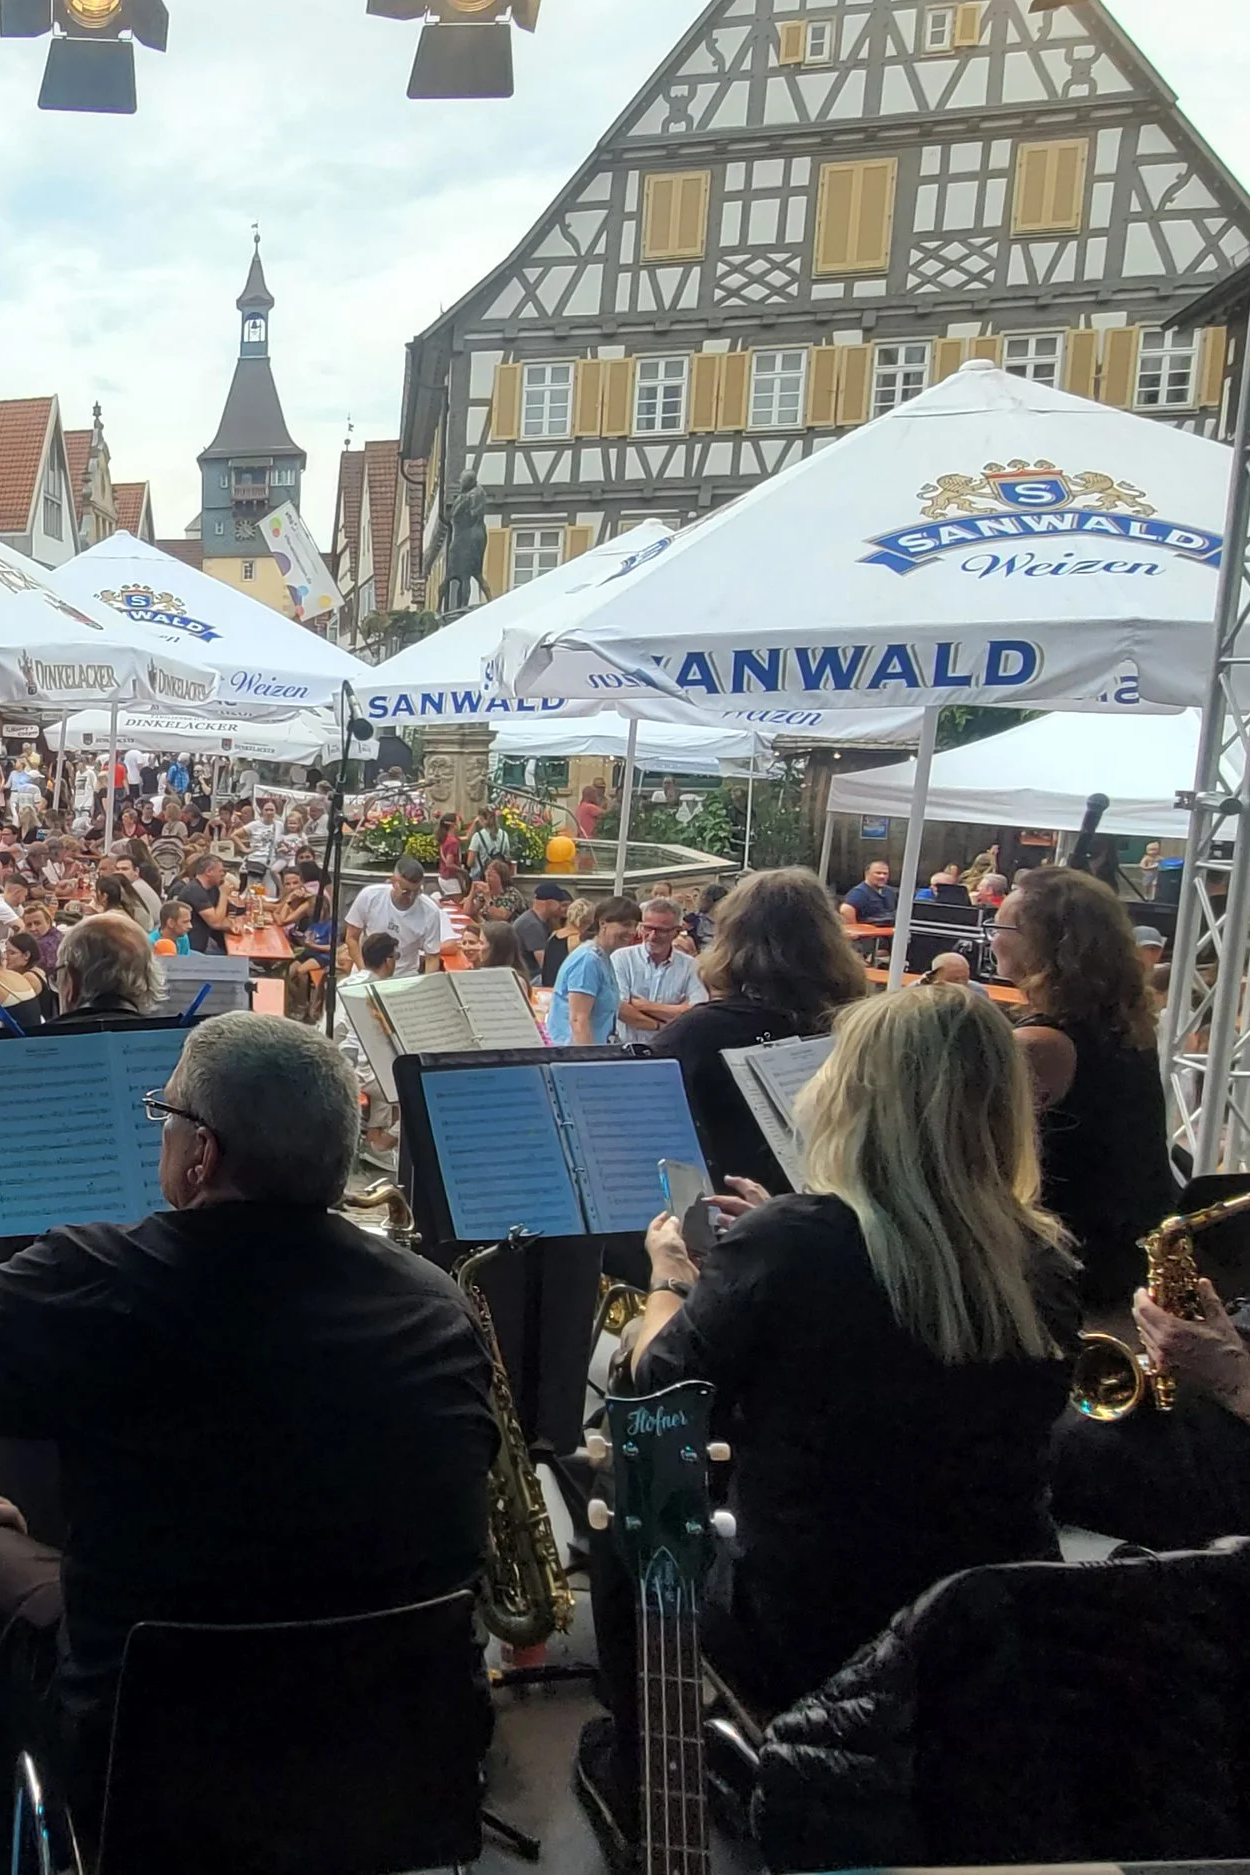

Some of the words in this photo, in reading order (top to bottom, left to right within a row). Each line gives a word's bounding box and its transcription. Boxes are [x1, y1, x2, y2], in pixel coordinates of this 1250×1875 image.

[1014, 483, 1056, 506] S
[898, 511, 1210, 554] SANWALD
[960, 552, 1167, 580] Weizen
[131, 595, 148, 607] S
[130, 610, 206, 634] WALD
[34, 659, 121, 693] DINKELACKER
[653, 639, 1046, 696] ANWALD
[230, 669, 310, 699] Weizen
[124, 717, 239, 733] DINKELACKER
